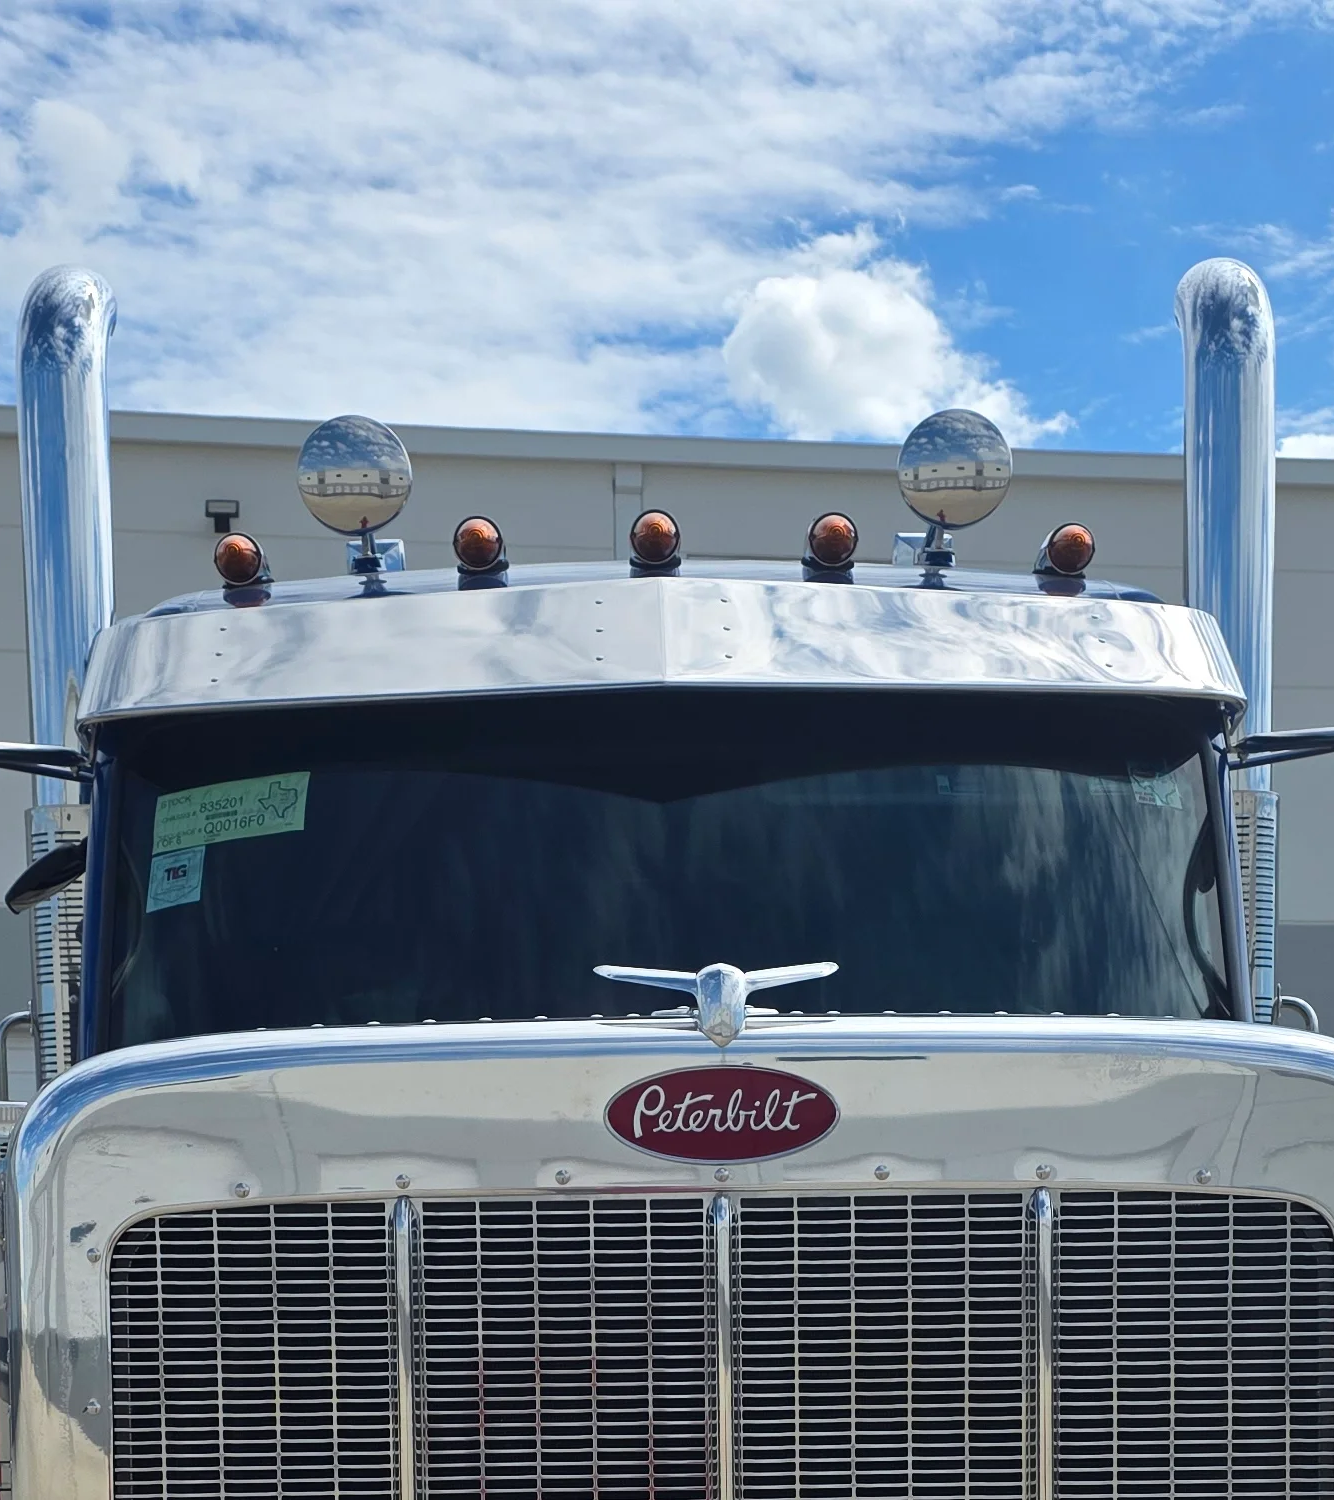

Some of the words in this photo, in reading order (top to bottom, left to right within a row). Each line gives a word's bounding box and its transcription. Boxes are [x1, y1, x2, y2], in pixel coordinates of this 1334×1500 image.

[199, 796, 244, 814] 835201
[204, 814, 265, 834] Q0016F0
[633, 1084, 817, 1139] Peterbilt
